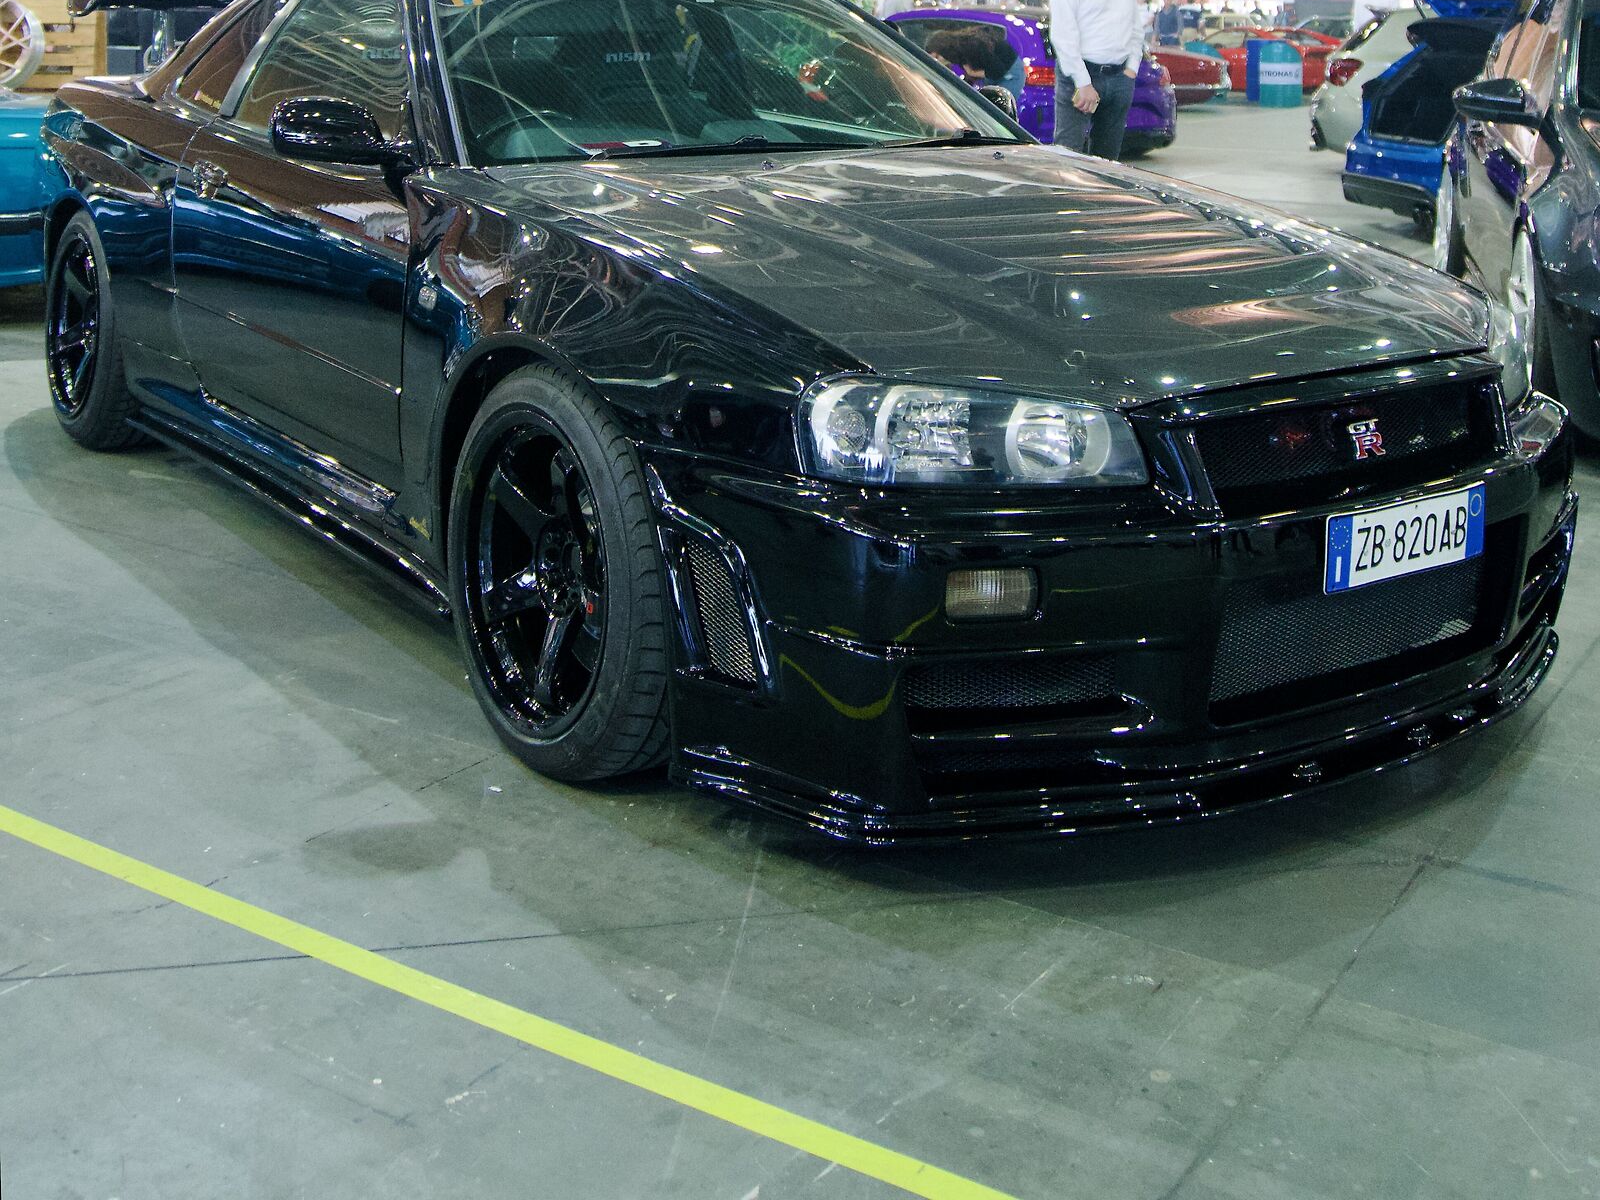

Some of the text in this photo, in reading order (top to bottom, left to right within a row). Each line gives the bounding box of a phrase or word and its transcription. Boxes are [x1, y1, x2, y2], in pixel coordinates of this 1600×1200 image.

[1348, 418, 1379, 434] GT
[1353, 431, 1387, 460] R
[1355, 524, 1386, 572] ZB
[1393, 506, 1467, 563] 820AB
